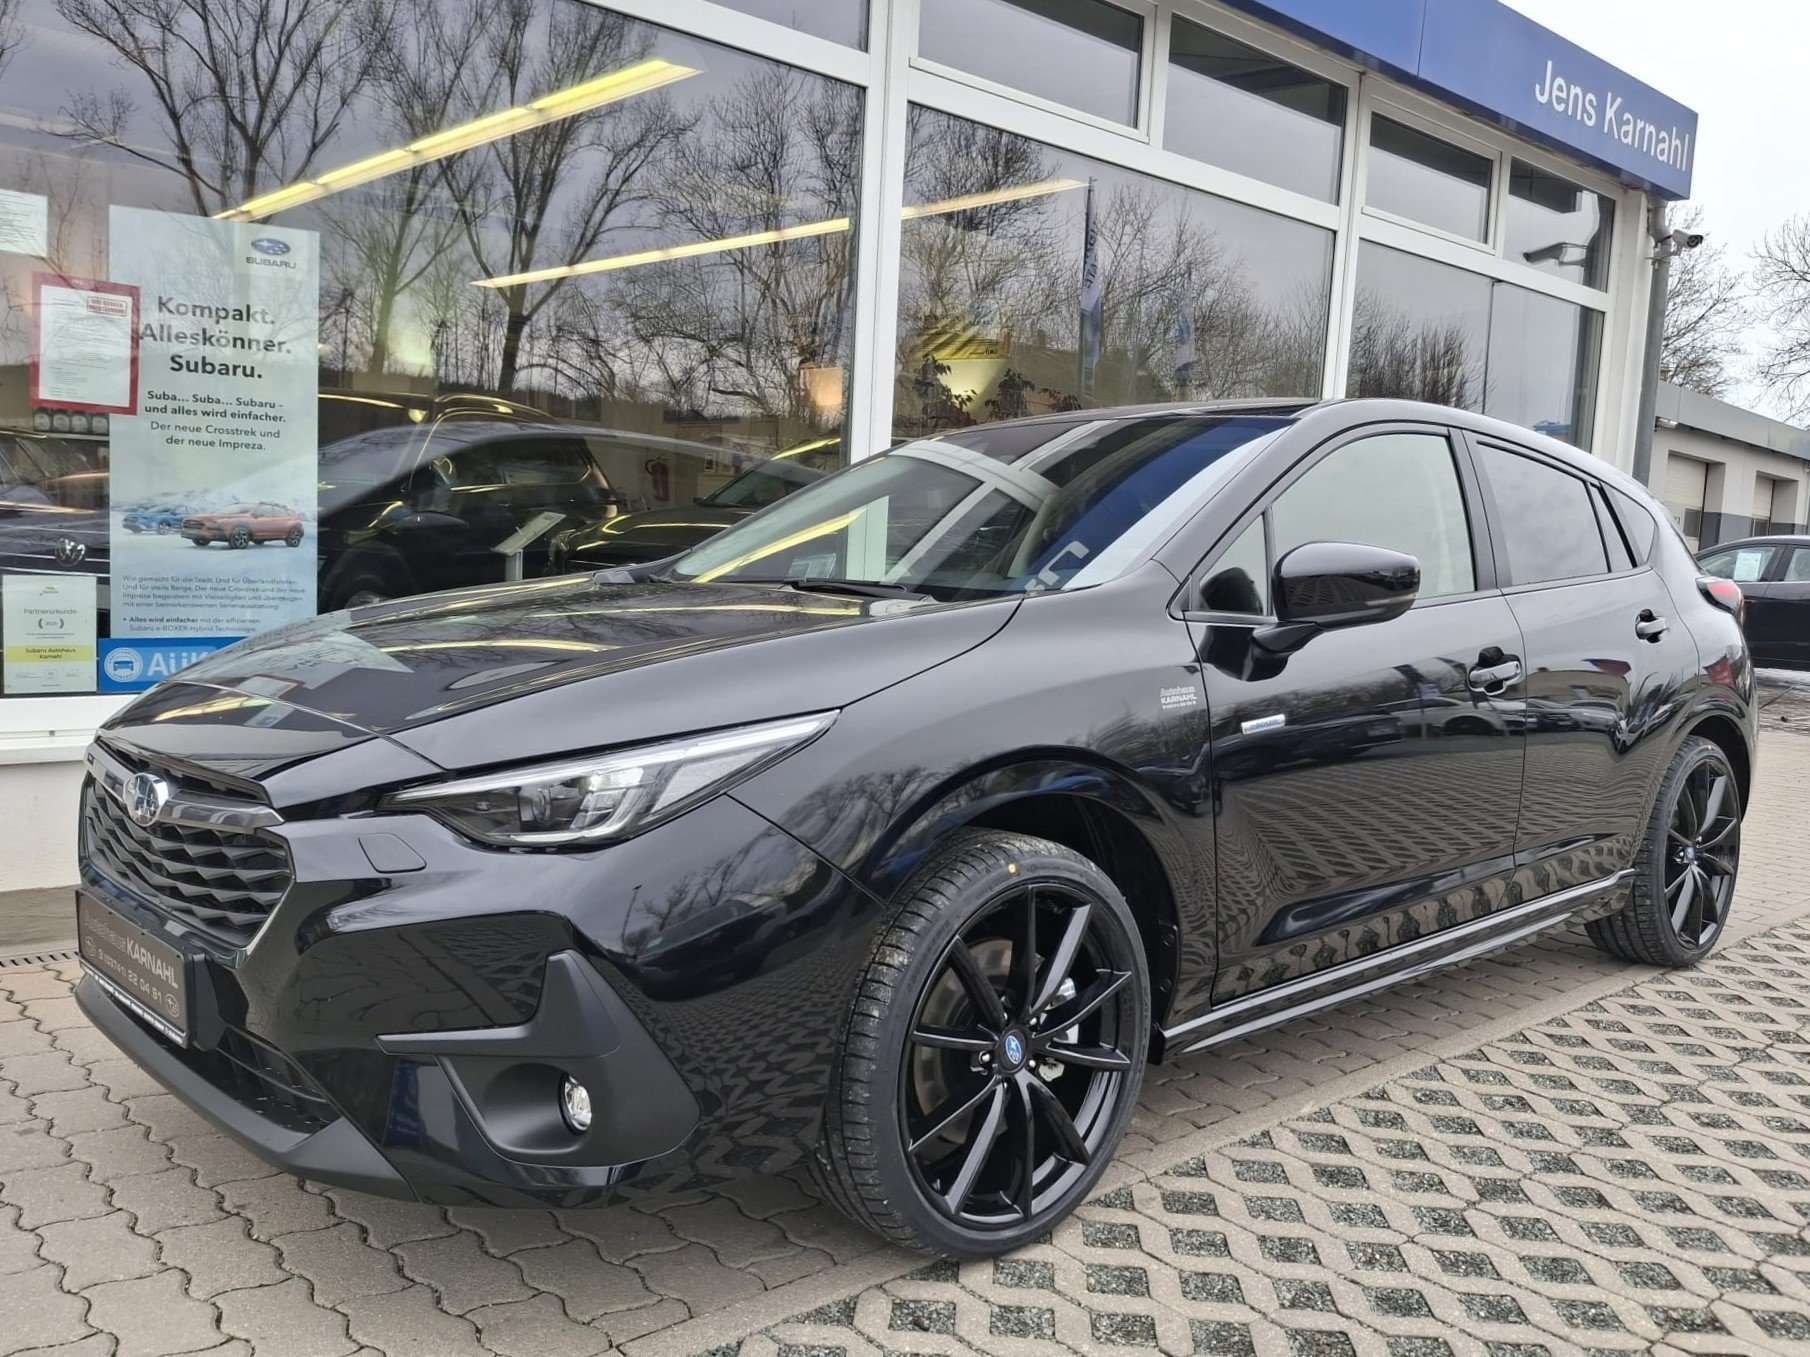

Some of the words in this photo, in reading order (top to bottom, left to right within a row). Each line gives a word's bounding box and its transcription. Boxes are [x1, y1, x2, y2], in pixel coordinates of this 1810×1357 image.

[1535, 60, 1597, 127] Jens
[1603, 91, 1689, 172] Karnahl
[245, 256, 296, 270] SUBARU
[158, 295, 276, 325] Kompakt.
[140, 323, 292, 354] Alleskönner.
[169, 354, 263, 379] Subaru.
[147, 390, 190, 402] Suba...
[192, 393, 233, 406] Suba...
[235, 396, 276, 409] Subaru
[144, 404, 168, 414] und
[170, 405, 198, 416] alles
[201, 408, 227, 418] wird
[230, 409, 287, 423] einfacher.
[150, 421, 171, 431] Der
[174, 424, 202, 433] neue
[205, 424, 257, 437] Crosstrek
[260, 429, 281, 439] und
[165, 435, 185, 446] der
[188, 439, 216, 447] neue
[218, 439, 266, 451] Impreza.
[126, 935, 179, 989] KARNAHL
